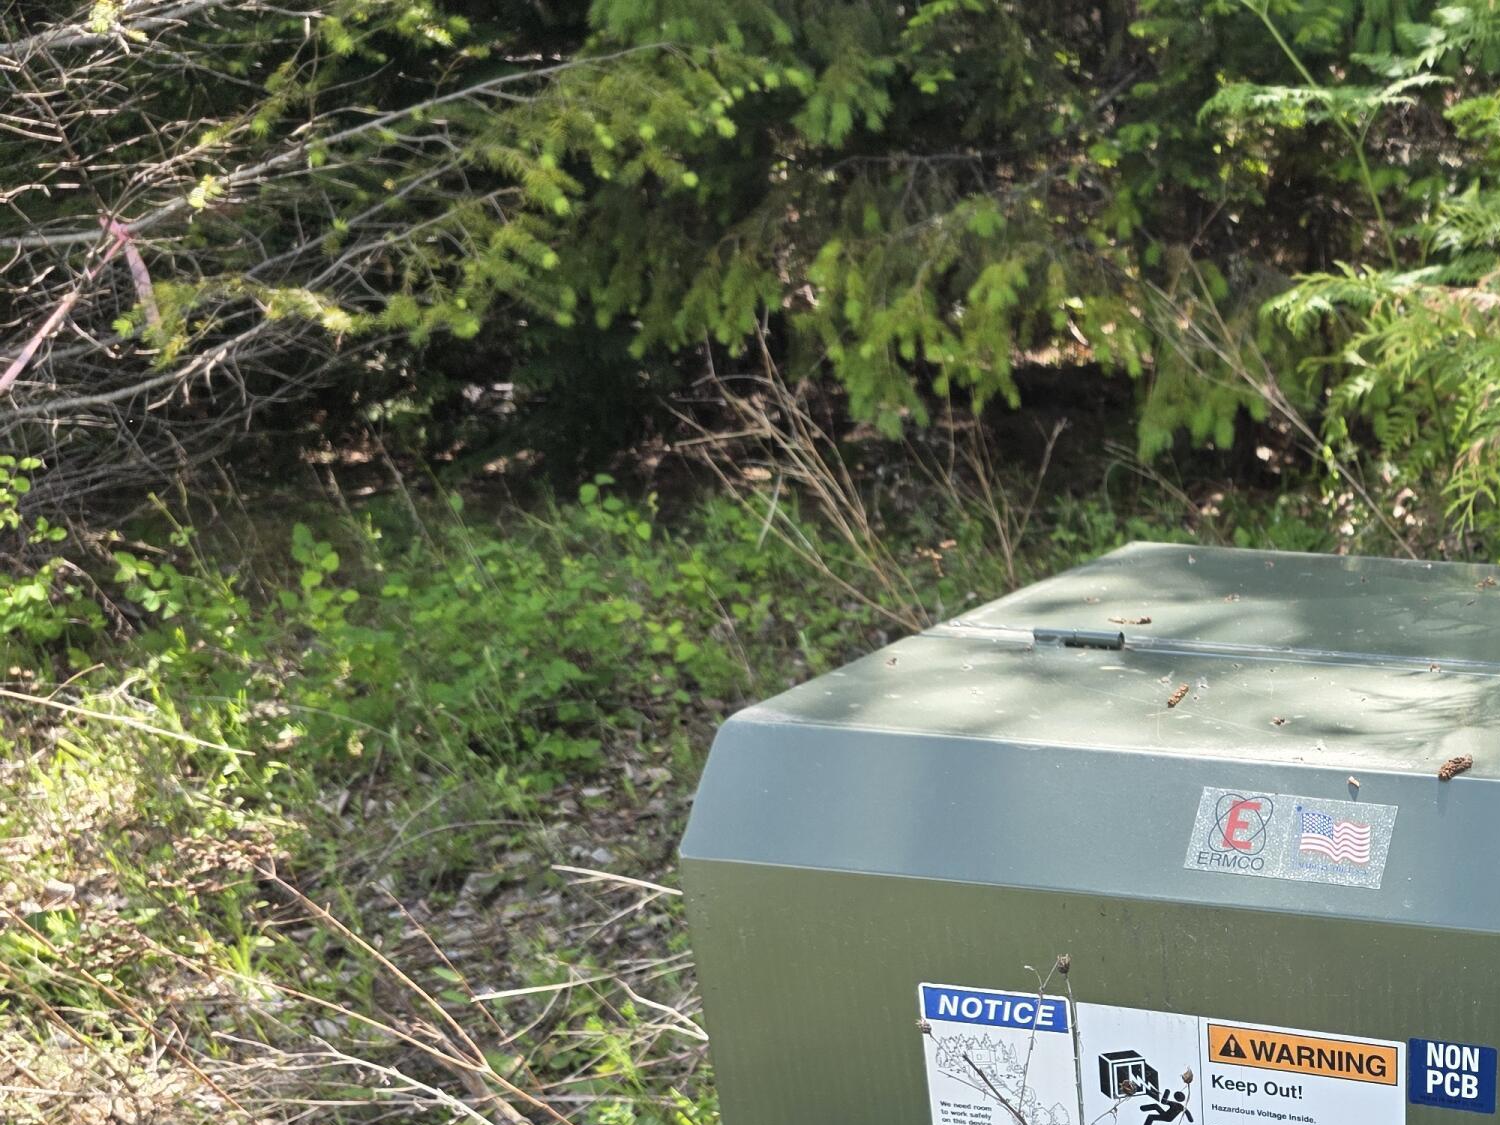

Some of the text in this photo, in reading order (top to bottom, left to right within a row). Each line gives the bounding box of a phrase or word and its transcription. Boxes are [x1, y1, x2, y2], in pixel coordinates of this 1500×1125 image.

[1221, 800, 1262, 850] E
[1196, 851, 1265, 871] ERMCO
[938, 994, 1055, 1026] NOTICE
[1250, 1039, 1387, 1077] WARNING
[1427, 1042, 1480, 1072] NON
[1211, 1074, 1303, 1099] Keep Out!
[1427, 1069, 1478, 1099] PCB
[970, 1112, 992, 1121] safely
[1211, 1103, 1317, 1124] Hazardous Voltage Inside.
